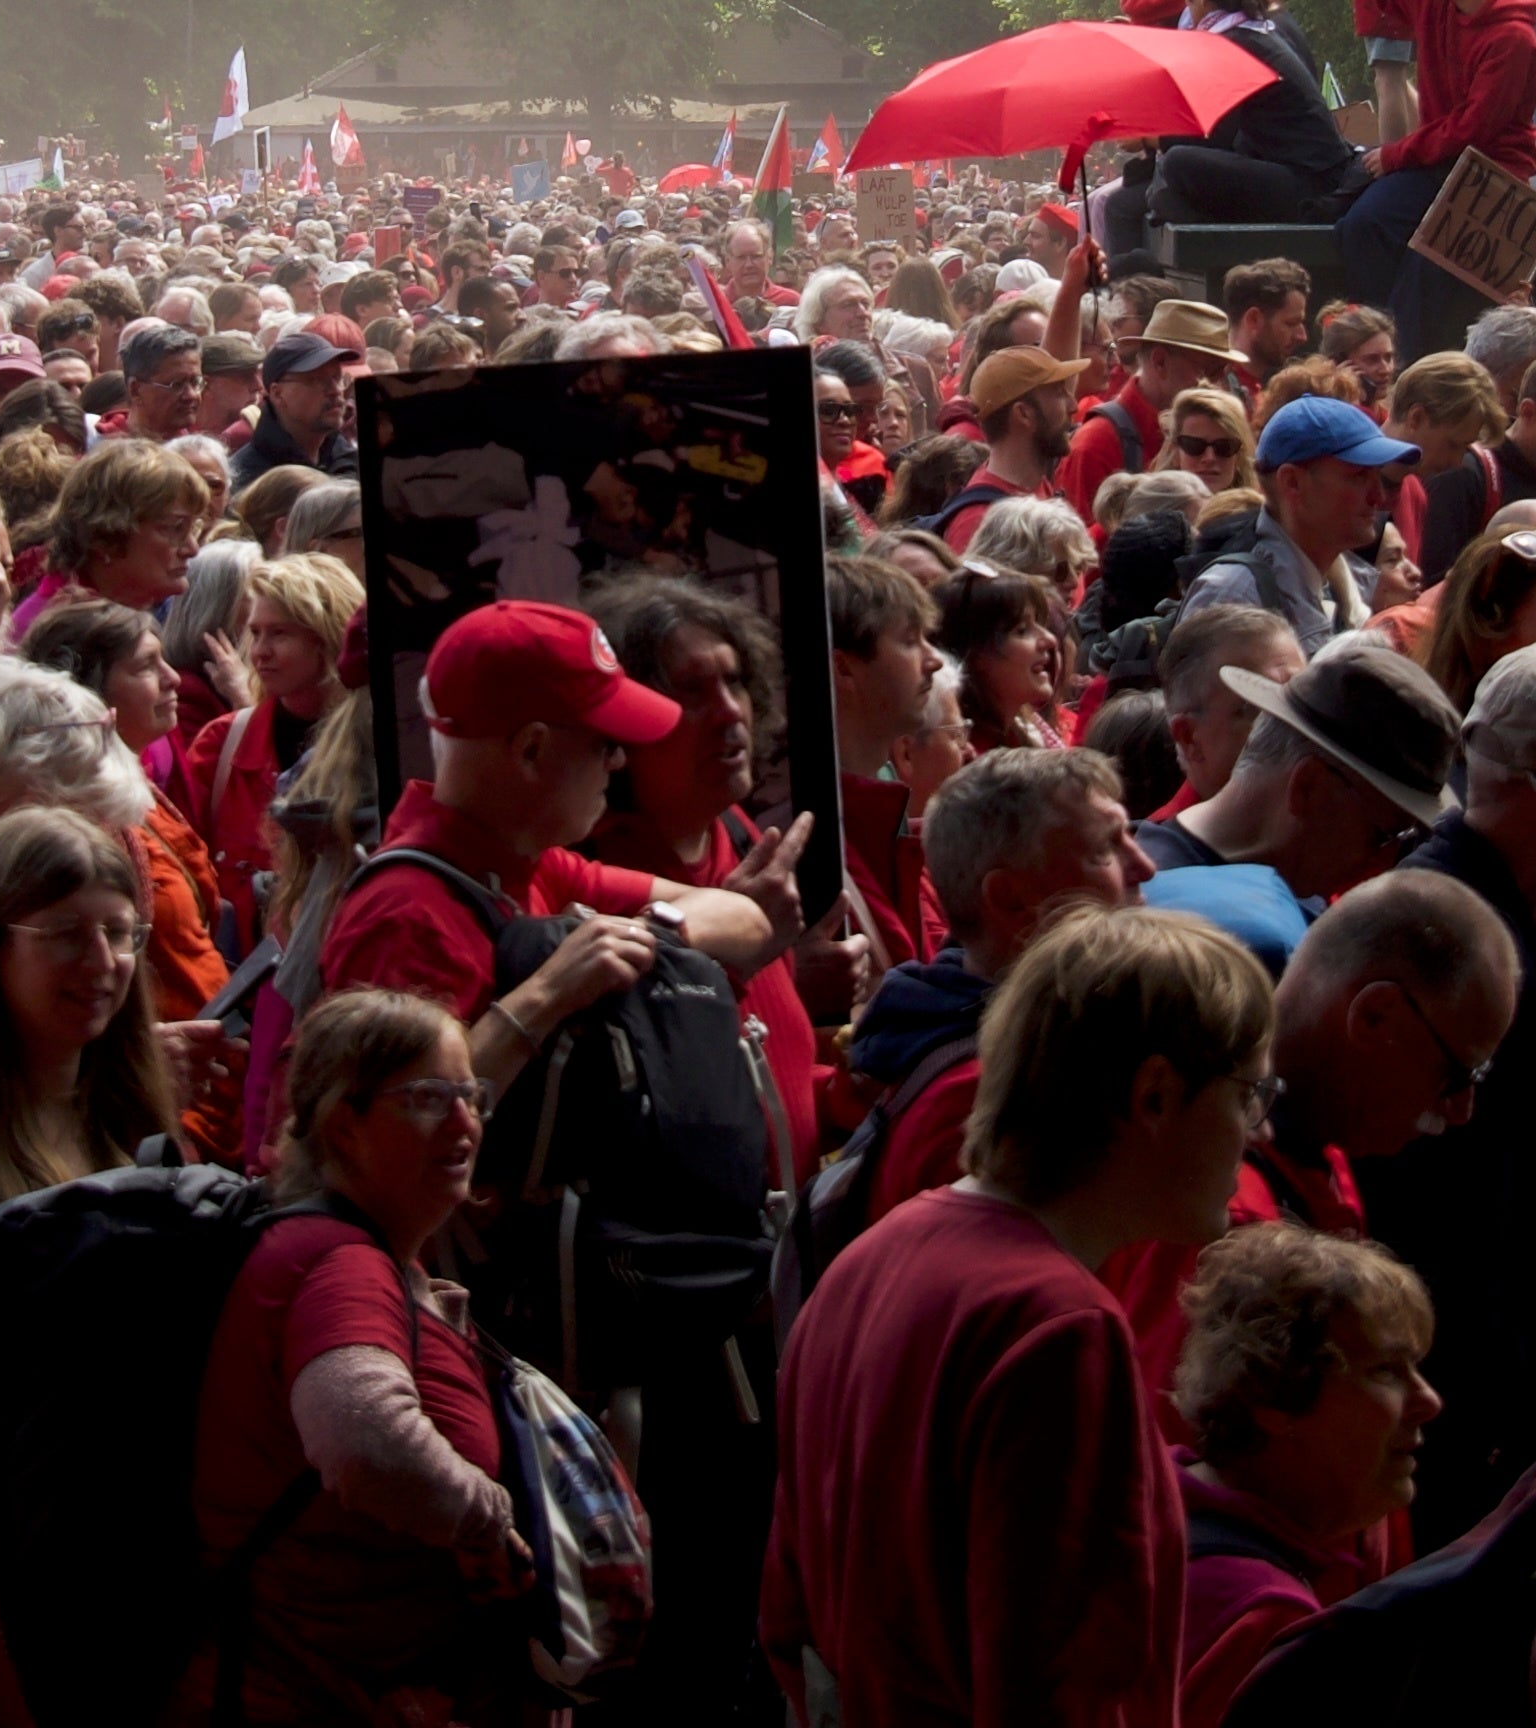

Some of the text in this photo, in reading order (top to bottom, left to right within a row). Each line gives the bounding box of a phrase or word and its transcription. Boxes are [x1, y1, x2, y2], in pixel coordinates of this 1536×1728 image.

[860, 176, 896, 194] LAAT
[886, 212, 907, 228] TOE
[1427, 209, 1526, 289] NOW
[0, 339, 22, 355] M
